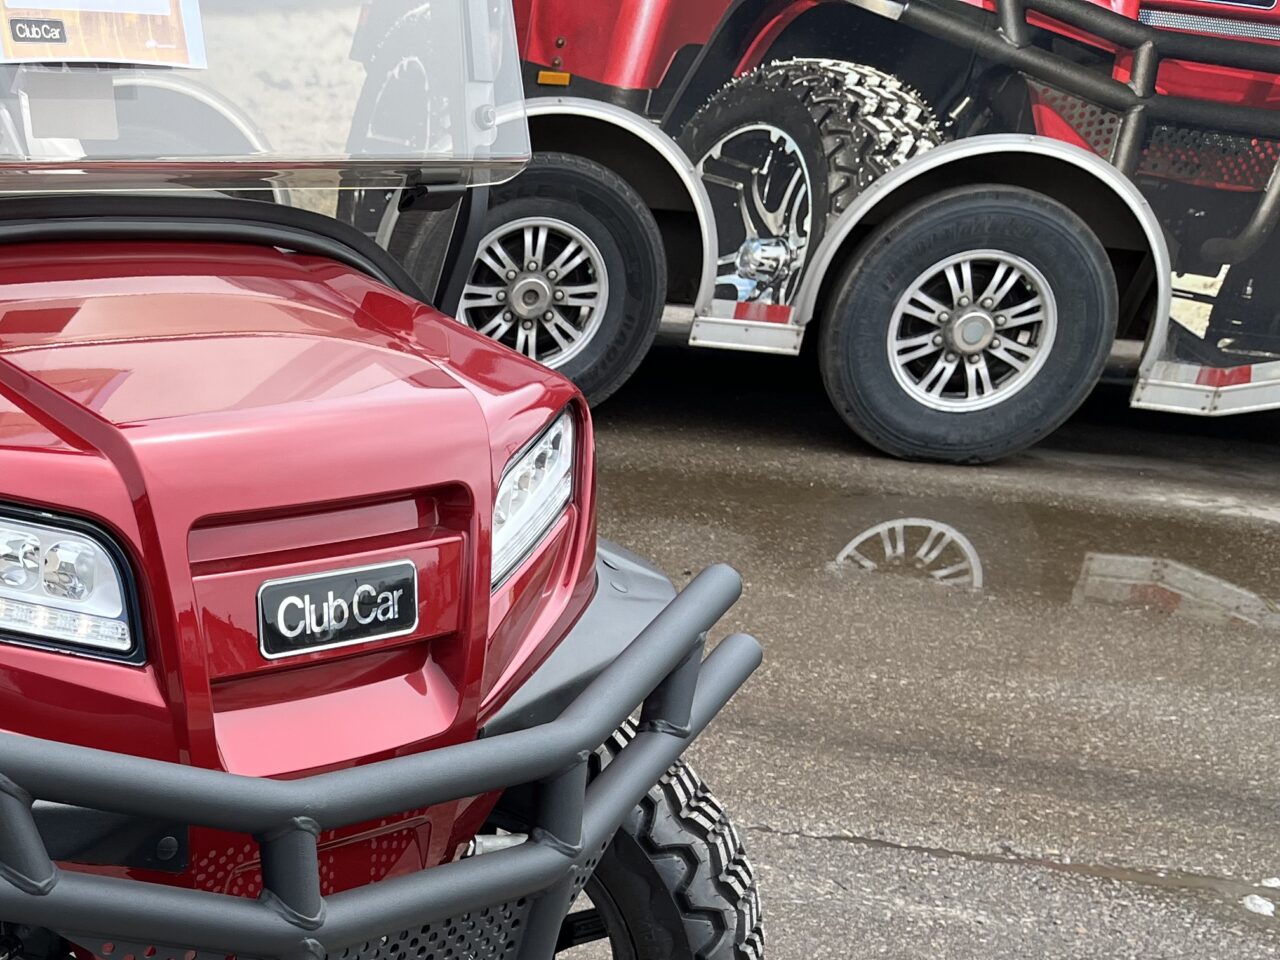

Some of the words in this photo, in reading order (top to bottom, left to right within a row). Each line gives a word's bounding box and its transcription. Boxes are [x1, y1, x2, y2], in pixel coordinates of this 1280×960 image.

[15, 23, 41, 38] Club
[42, 24, 61, 39] Car
[277, 591, 349, 637] Club
[353, 584, 403, 624] Car
